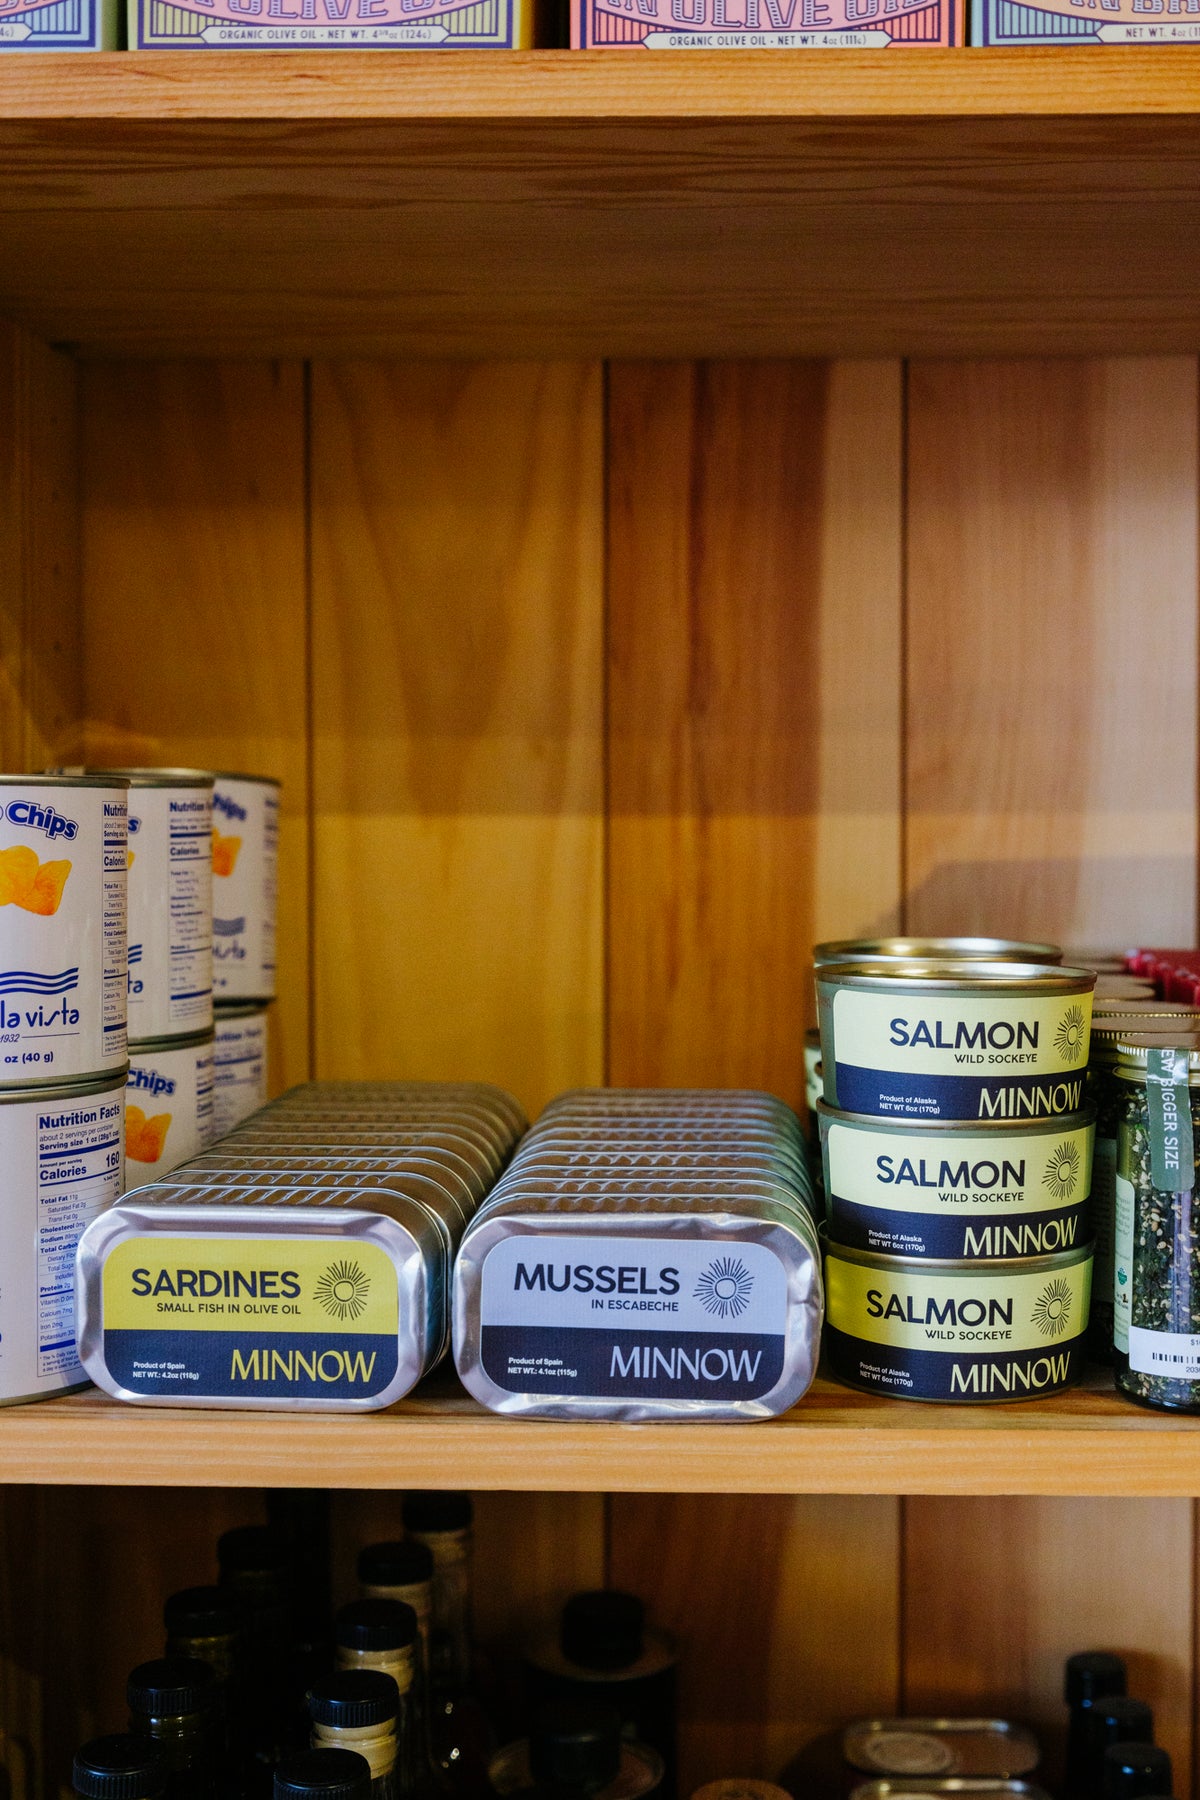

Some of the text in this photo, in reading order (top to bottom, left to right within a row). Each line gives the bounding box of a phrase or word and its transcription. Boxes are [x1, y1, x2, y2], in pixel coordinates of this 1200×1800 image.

[219, 29, 263, 39] ORGANIC
[267, 29, 297, 39] OLIVE
[300, 29, 316, 39] OIL
[327, 29, 345, 39] NET
[1125, 27, 1143, 38] NET
[669, 36, 713, 46] ORGANIC
[717, 36, 746, 46] OLIVE
[751, 35, 766, 45] OIL
[777, 35, 796, 45] NET
[6, 801, 78, 839] Chips
[26, 997, 79, 1027] vista
[889, 1018, 1039, 1049] SALMON
[22, 1053, 40, 1064] (40
[44, 1051, 53, 1063] g)
[954, 1053, 1037, 1064] WILD SOCKEYE
[880, 1094, 904, 1103] Product
[978, 1080, 1082, 1117] MINNOW
[919, 1106, 940, 1114] (170g)
[1161, 1048, 1179, 1170] EW BIGGER SIZE
[39, 1104, 120, 1130] Nutrition Facts
[40, 1133, 58, 1142] about
[65, 1129, 87, 1139] servings
[88, 1127, 96, 1135] per
[40, 1141, 68, 1151] Serving
[106, 1151, 119, 1168] 160
[40, 1166, 87, 1181] Calories
[876, 1155, 1025, 1188] SALMON
[938, 1192, 1024, 1203] WILD SOCKEYE
[48, 1204, 71, 1213] Saturated
[40, 1223, 75, 1234] Cholesterol
[40, 1236, 63, 1244] Sodium
[868, 1229, 891, 1239] Product
[900, 1234, 922, 1243] Alaska
[963, 1215, 1078, 1256] MINNOW
[40, 1245, 57, 1253] Total
[868, 1238, 880, 1246] NET
[905, 1243, 926, 1252] (170g)
[48, 1254, 65, 1263] Dietary
[132, 1268, 300, 1299] SARDINES
[514, 1263, 680, 1295] MUSSELS
[40, 1284, 63, 1293] Protein
[40, 1297, 60, 1306] Vitamin
[591, 1299, 679, 1312] IN ESCABECHE
[866, 1289, 1013, 1326] SALMON
[40, 1309, 61, 1318] Calcium
[157, 1302, 301, 1315] SMALL FISH IN OLIVE OIL
[40, 1331, 67, 1341] Potassium
[925, 1329, 1012, 1341] WILD SOCKEYE
[133, 1361, 185, 1370] Product of Spain
[231, 1349, 376, 1383] MINNOW
[508, 1357, 535, 1365] Product
[543, 1358, 563, 1366] Spain
[610, 1346, 762, 1382] MINNOW
[162, 1371, 179, 1379] 4.2oz
[859, 1361, 880, 1373] Product
[888, 1368, 910, 1378] Alaska
[950, 1351, 1070, 1393] MINNOW
[860, 1370, 914, 1387] NET WT 6oz (170g)
